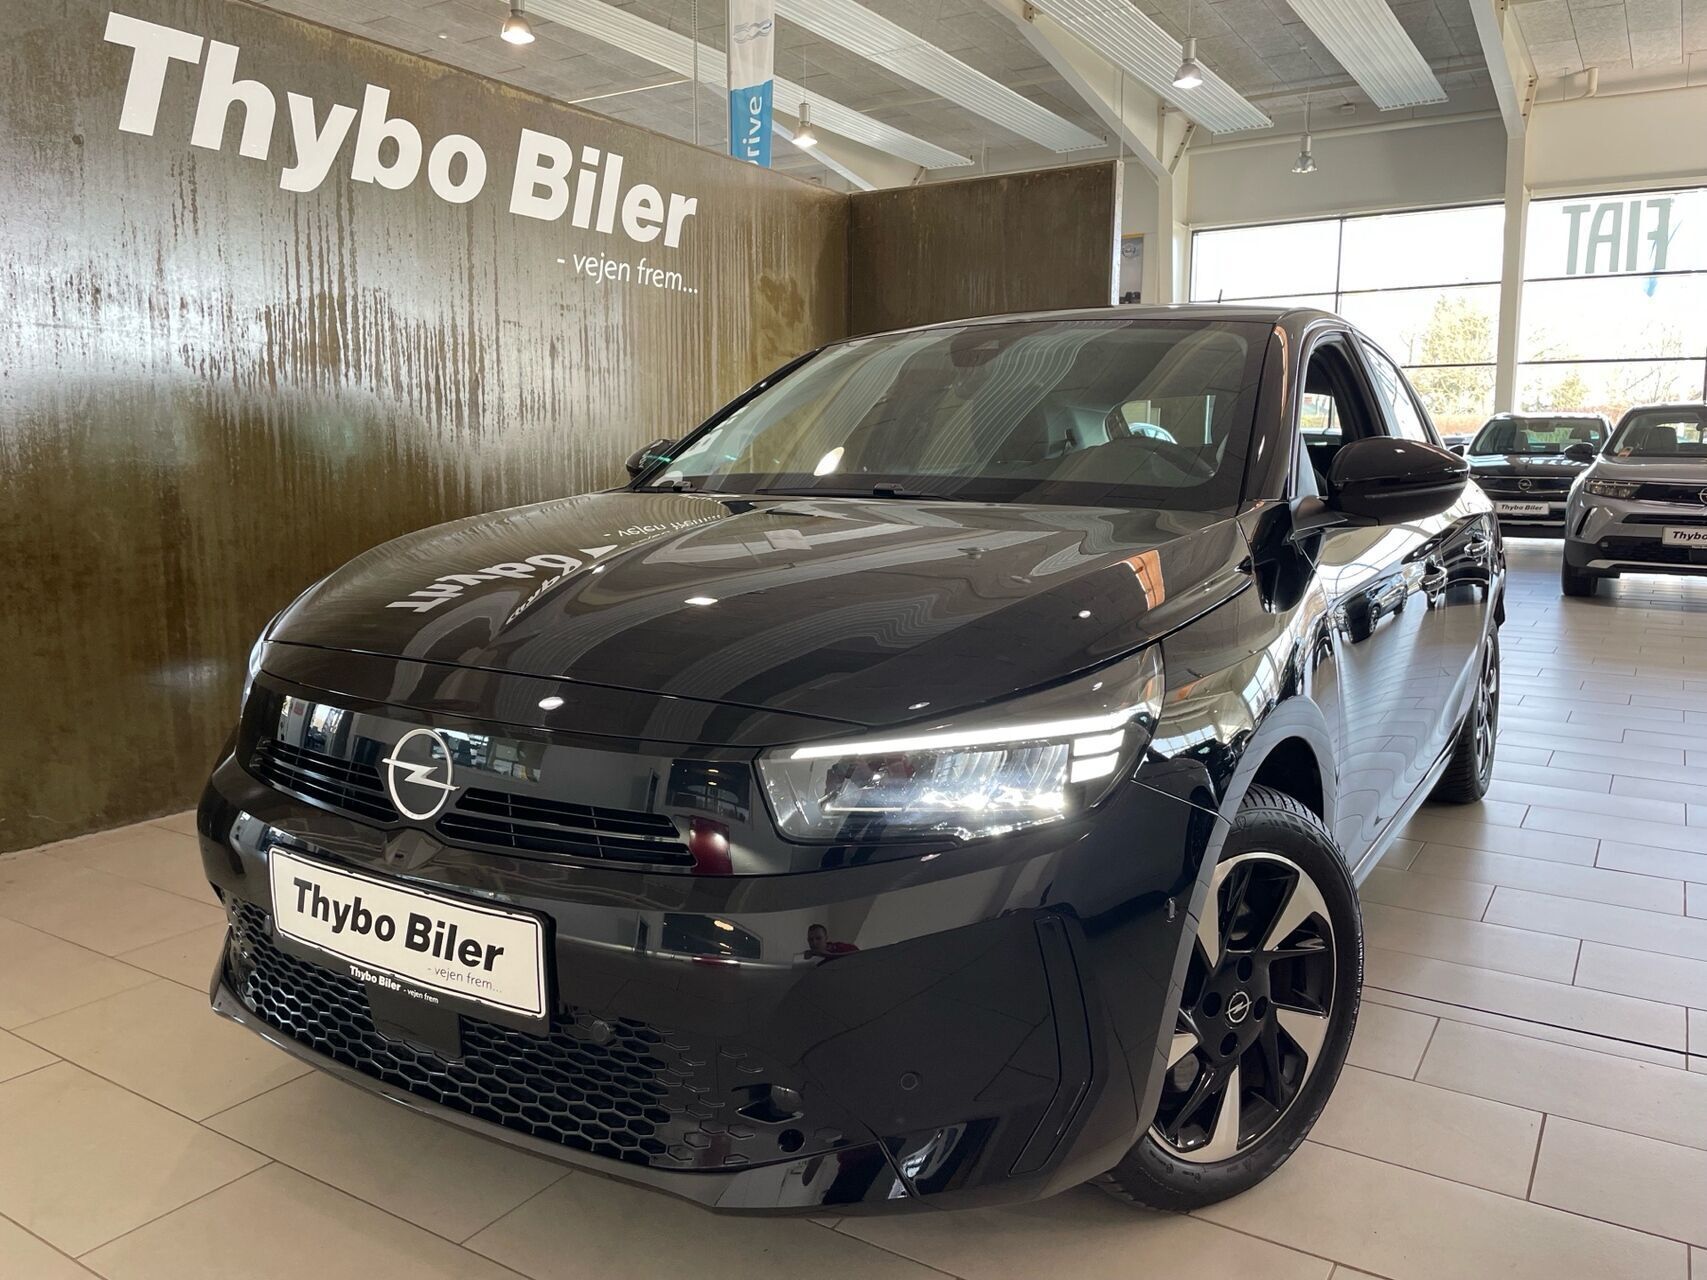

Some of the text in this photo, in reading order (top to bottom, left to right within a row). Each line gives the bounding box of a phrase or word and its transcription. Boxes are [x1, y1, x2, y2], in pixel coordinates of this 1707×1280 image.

[104, 12, 698, 248] Thybo Biler
[573, 252, 630, 284] vejen
[637, 258, 698, 293] frem...
[293, 877, 504, 972] Thybo Biler
[349, 965, 377, 983] Thybo
[378, 976, 401, 991] Biler
[407, 988, 424, 999] vejen
[424, 993, 439, 1004] frem
[434, 967, 464, 981] vejen
